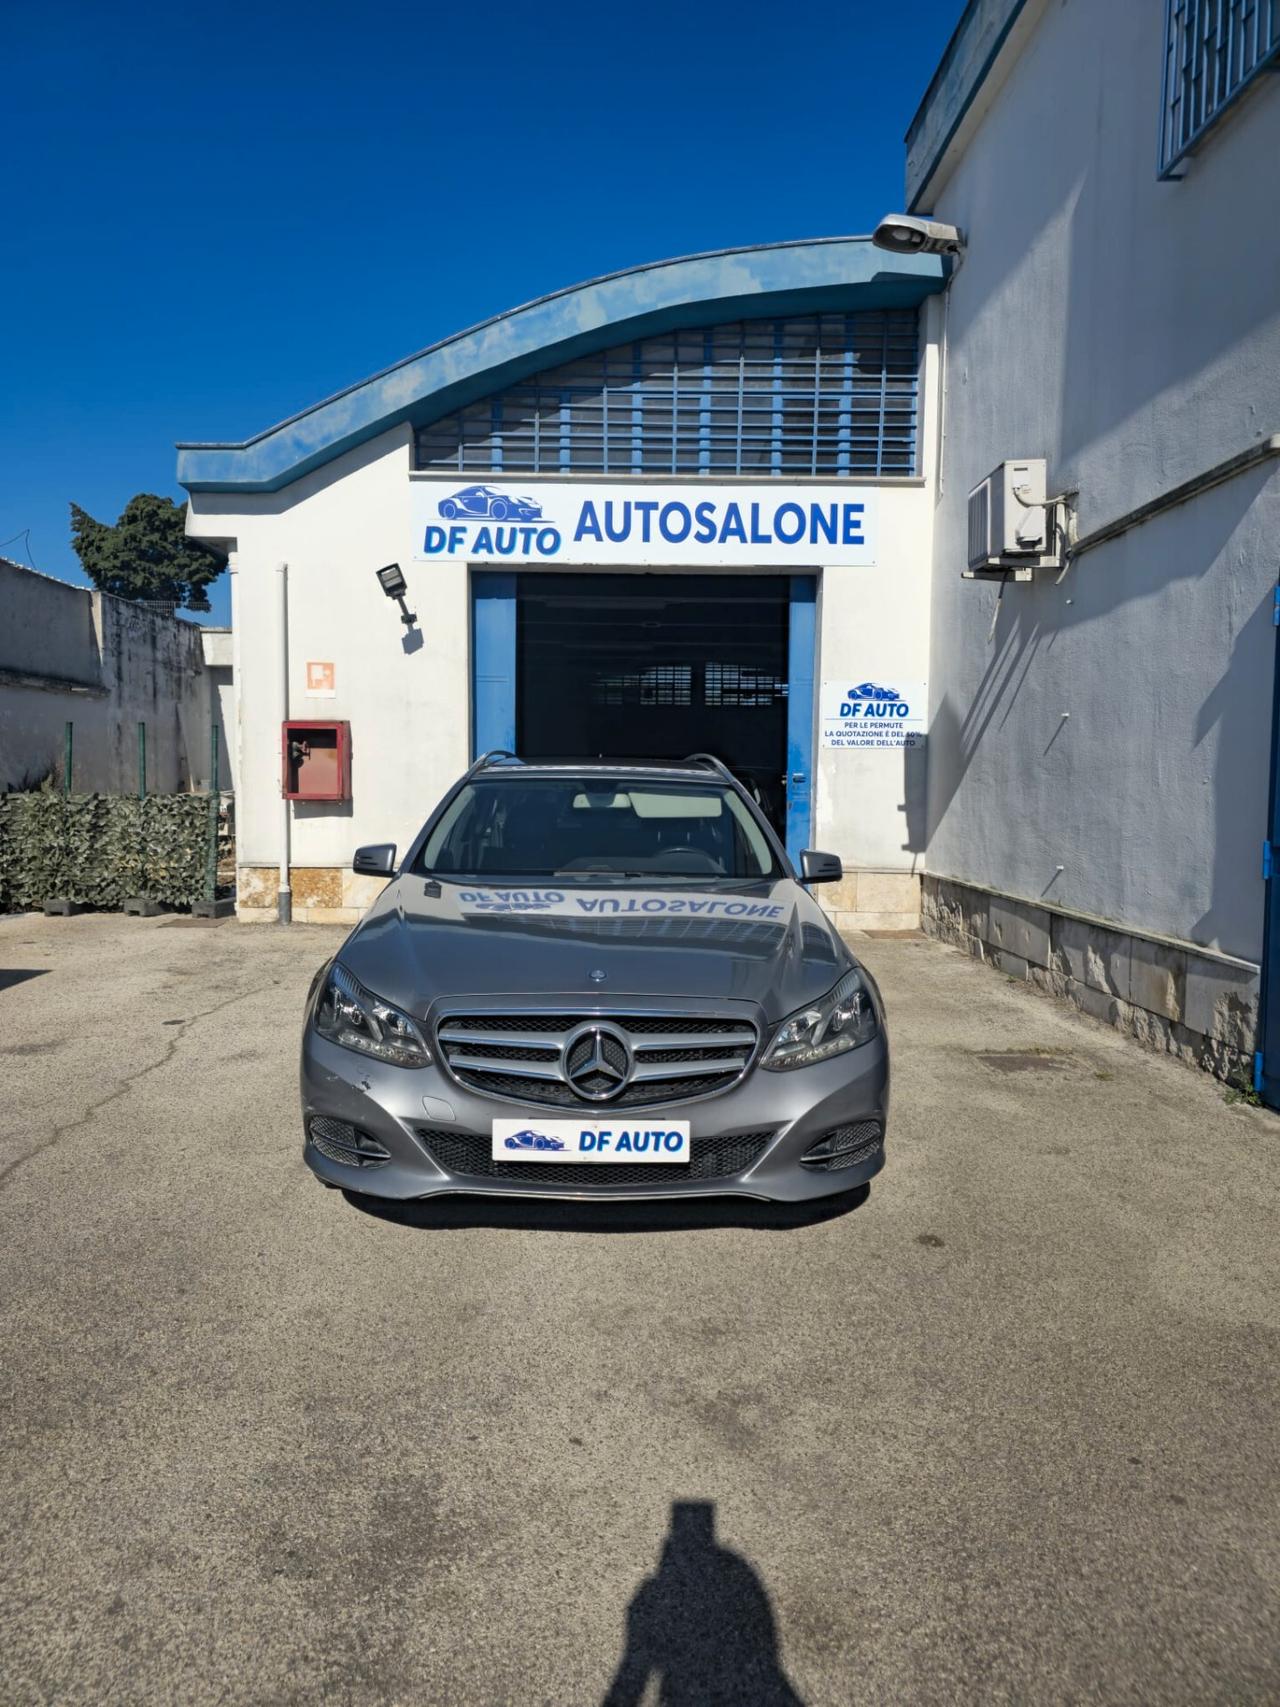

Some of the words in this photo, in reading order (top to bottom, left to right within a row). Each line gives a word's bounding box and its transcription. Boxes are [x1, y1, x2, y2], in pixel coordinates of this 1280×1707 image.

[573, 500, 865, 545] AUTOSALONE
[423, 525, 466, 554] DF
[471, 526, 562, 555] AUTO
[840, 703, 862, 717] DF
[863, 703, 909, 717] AUTO
[579, 1131, 612, 1152] DF
[615, 1131, 684, 1152] AUTO
